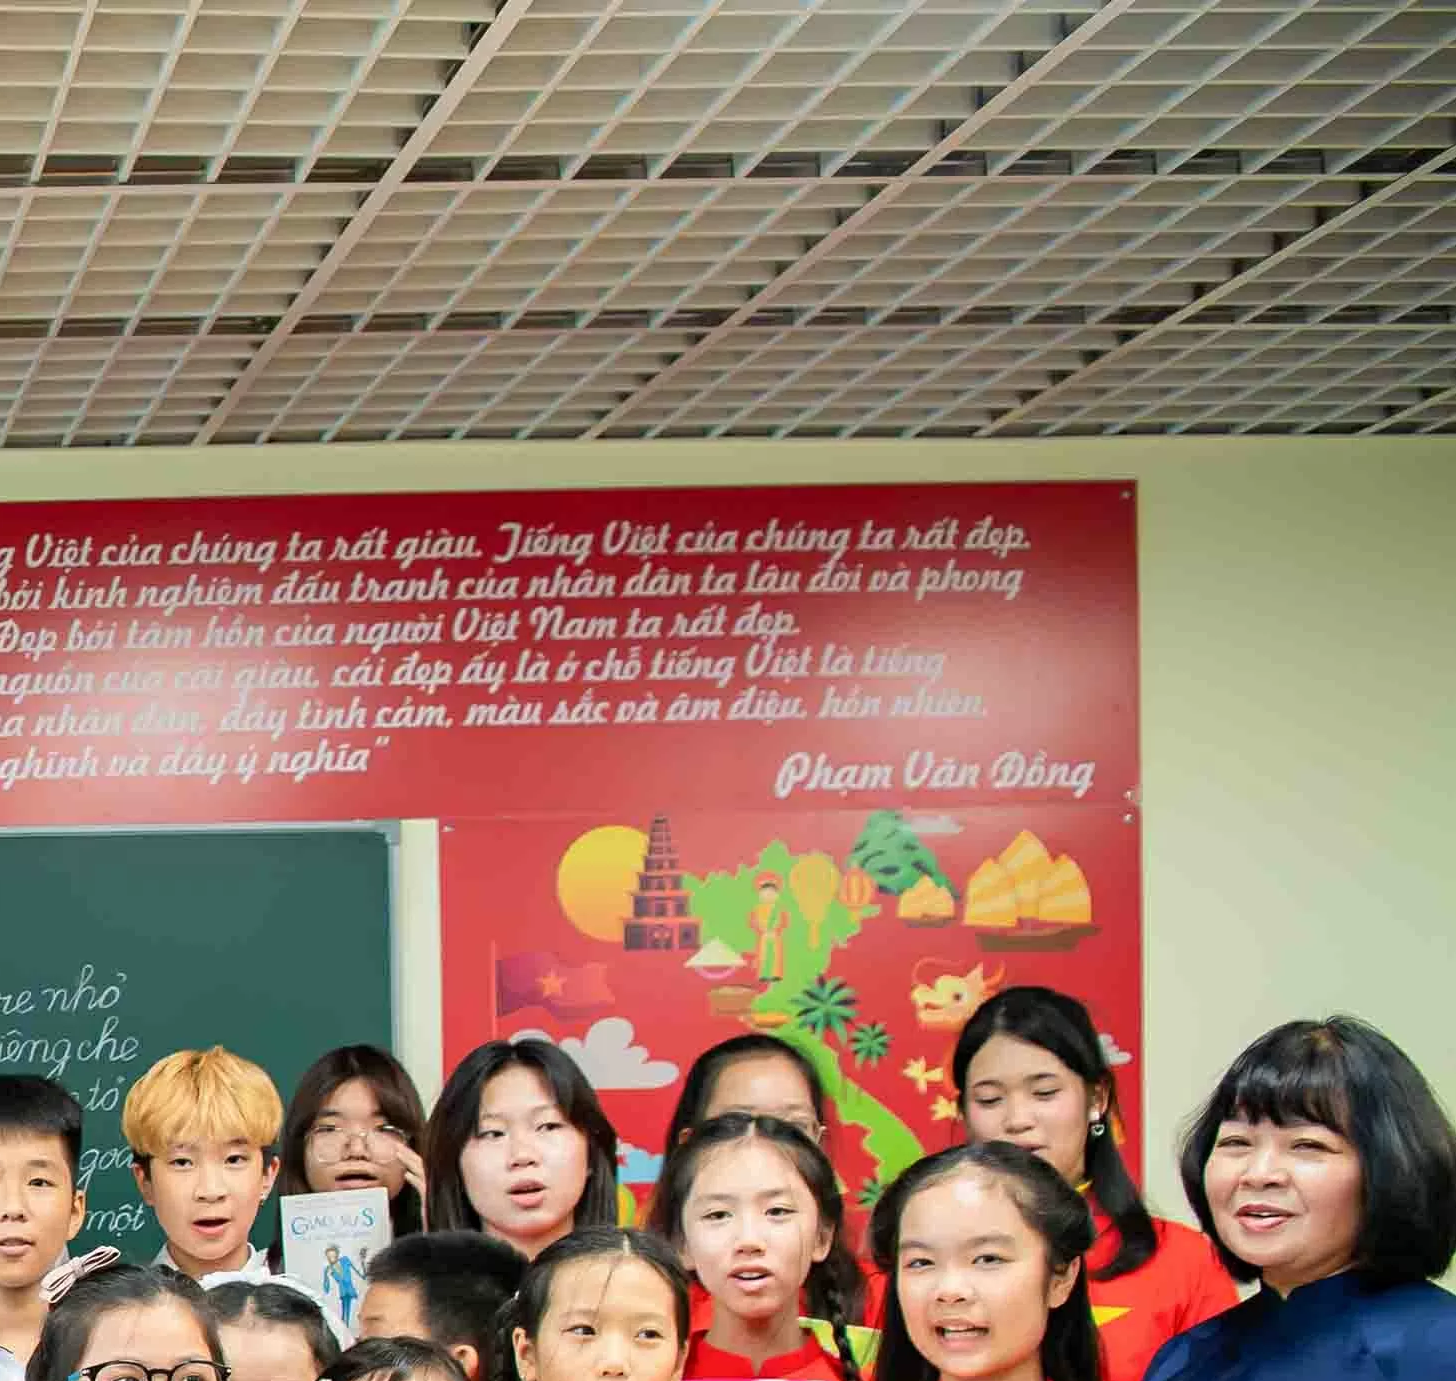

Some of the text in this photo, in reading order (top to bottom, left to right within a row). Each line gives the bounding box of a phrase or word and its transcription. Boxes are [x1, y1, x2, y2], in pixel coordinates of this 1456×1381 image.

[25, 532, 93, 573] Việt
[97, 533, 163, 567] của
[167, 530, 279, 573] chúng
[282, 531, 324, 562] ta
[327, 526, 389, 562] rất
[491, 520, 595, 565] Tiếng
[601, 520, 671, 560] Việt
[674, 520, 739, 554] của
[742, 517, 852, 565] chúng
[855, 519, 895, 551] ta
[901, 516, 959, 550] rất
[964, 515, 1031, 558] đẹp.
[48, 576, 127, 610] kinh
[135, 574, 263, 616] nghiệm
[269, 570, 341, 604] đấu
[345, 568, 450, 604] tranh
[453, 568, 519, 600] của
[523, 566, 617, 599] nhân
[621, 562, 692, 597] dân
[696, 564, 737, 596] ta
[741, 560, 801, 594] lâu
[807, 558, 862, 596] đời
[869, 559, 911, 592] và
[915, 559, 1024, 602] phong
[774, 749, 1095, 799] Phạm Văn Đồng
[42, 964, 128, 1014] nhỏ
[77, 1015, 139, 1065] che
[87, 1204, 147, 1243] một
